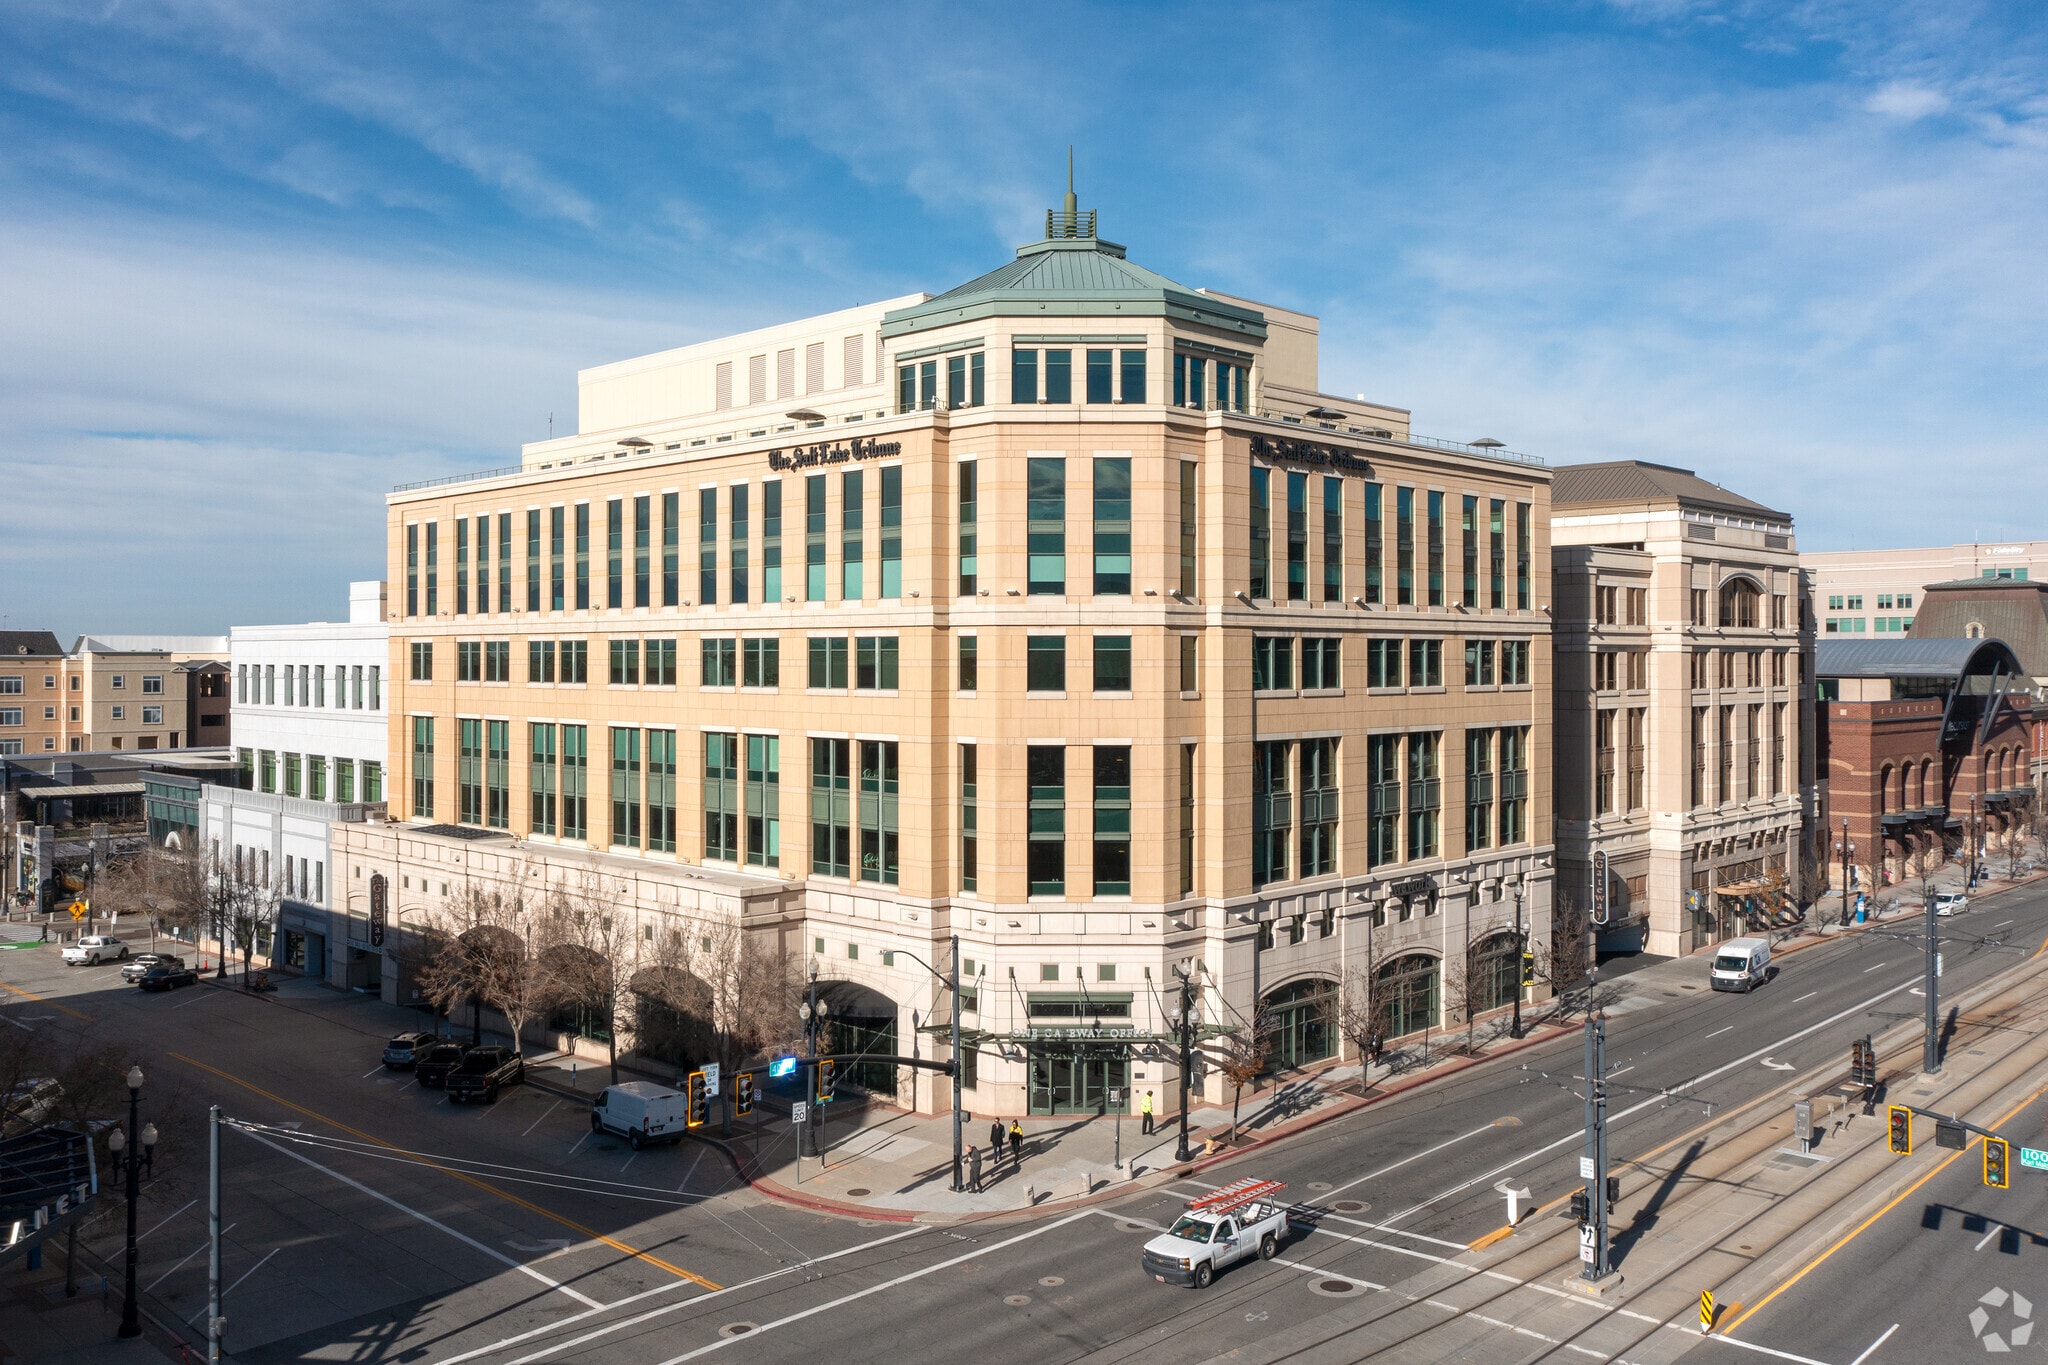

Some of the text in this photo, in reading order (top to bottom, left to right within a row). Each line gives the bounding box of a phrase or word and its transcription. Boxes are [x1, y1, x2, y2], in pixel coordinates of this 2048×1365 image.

[768, 437, 902, 473] The Salt Lake Tribune
[1252, 435, 1370, 470] The Salt Lake Tribune
[1992, 546, 2025, 554] Fidelity
[1594, 860, 1605, 920] Gateway
[372, 884, 382, 944] Gateway
[1012, 1028, 1038, 1039] ONE
[1110, 1028, 1153, 1038] OFFICE
[794, 1112, 804, 1120] 20
